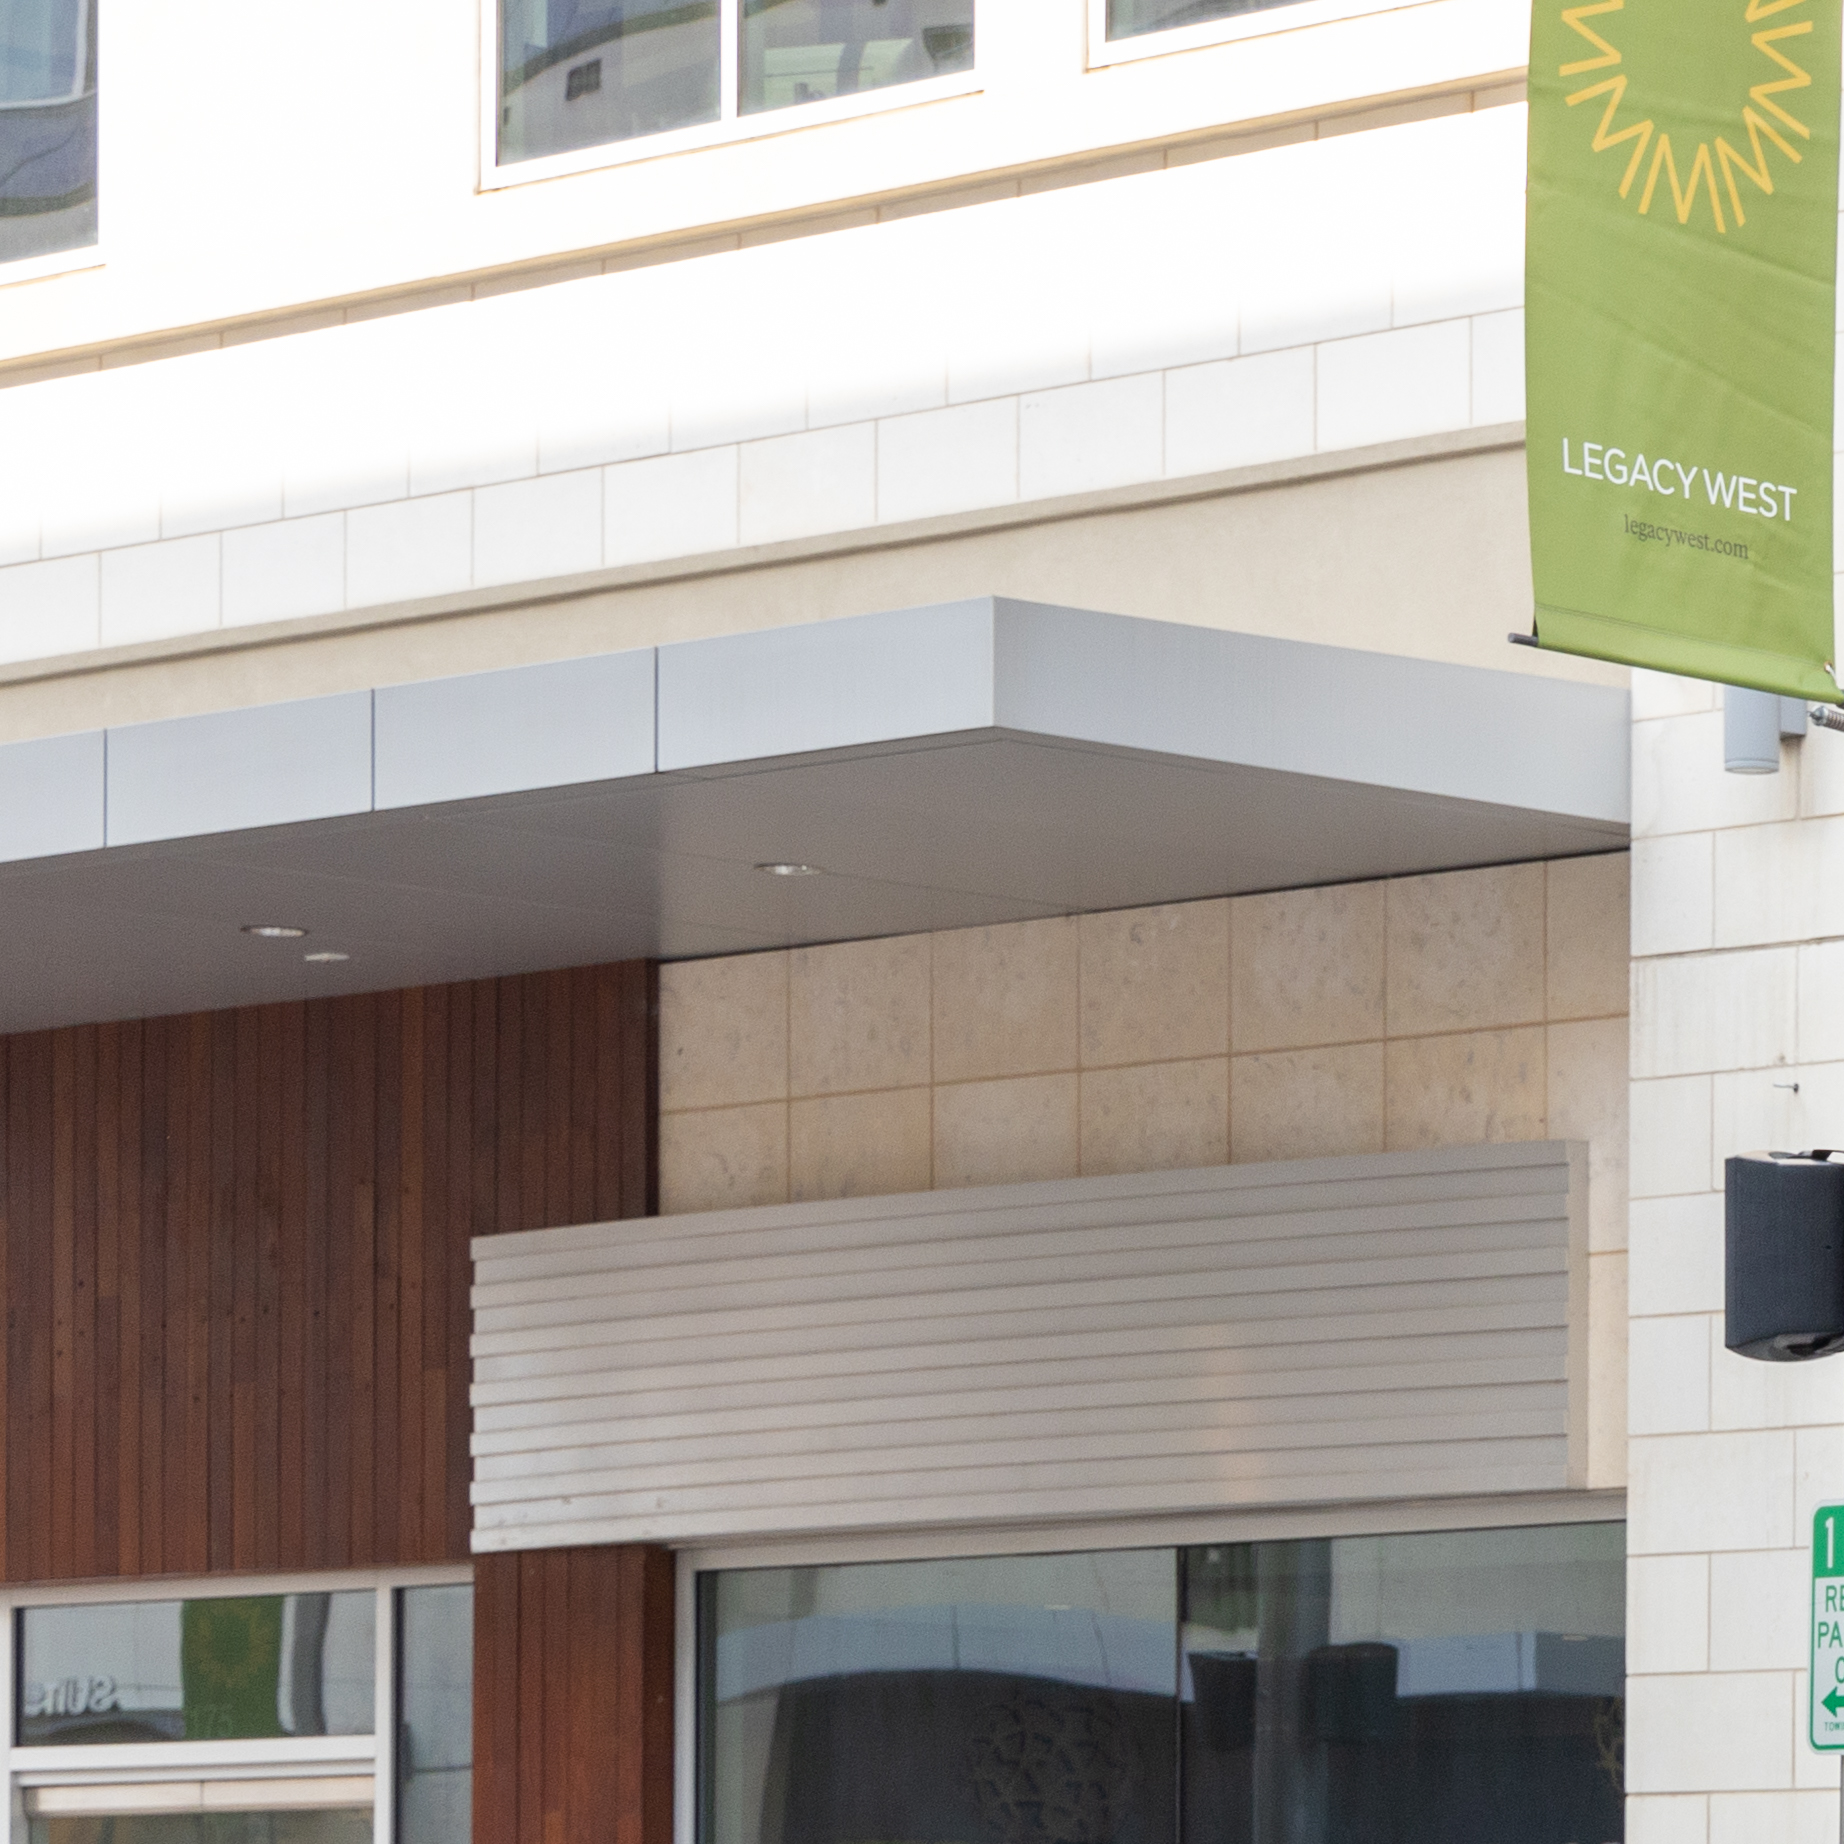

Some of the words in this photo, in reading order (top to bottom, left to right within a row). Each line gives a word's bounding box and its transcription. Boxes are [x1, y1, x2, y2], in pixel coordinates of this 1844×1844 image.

[1562, 436, 1700, 501] LEGACY
[1702, 467, 1798, 522] WEST
[1623, 513, 1750, 560] legacywest.com
[1824, 1516, 1835, 1570] 1
